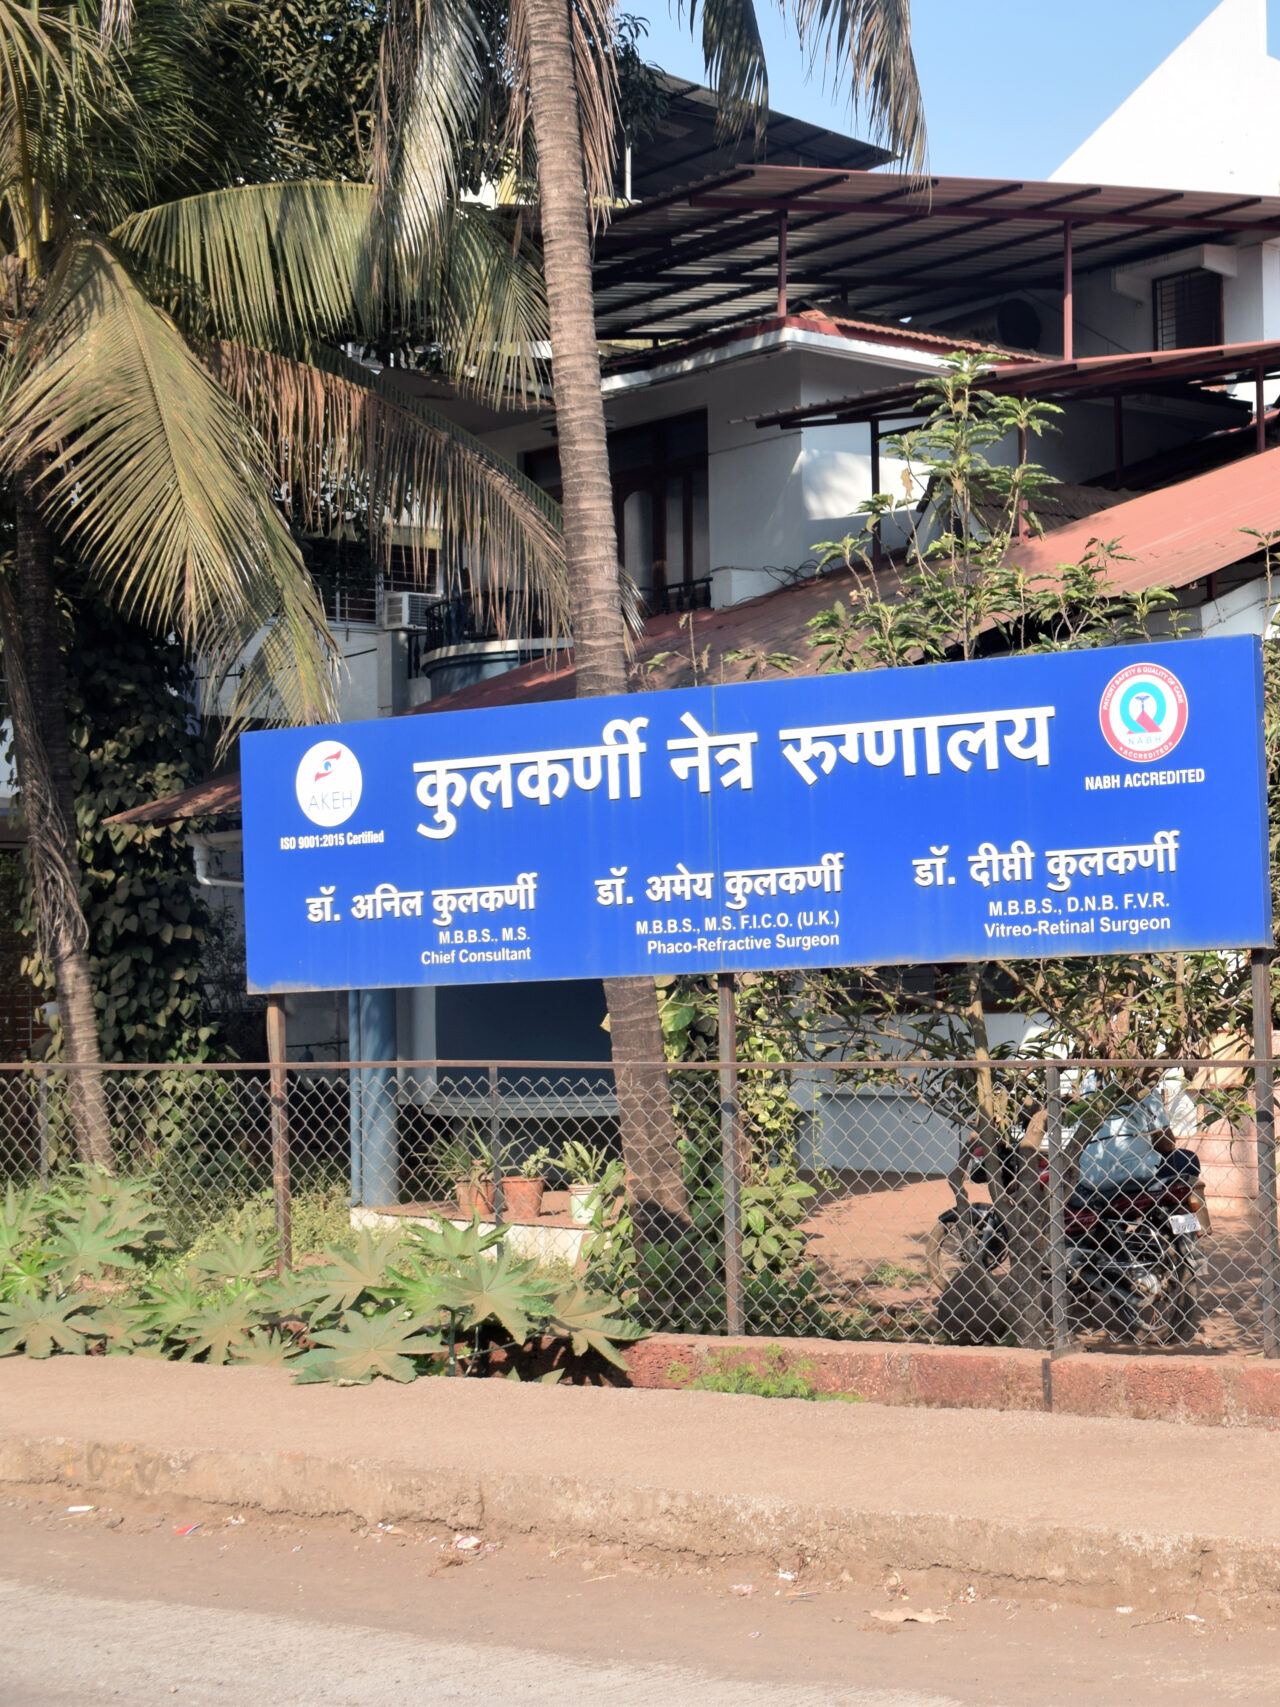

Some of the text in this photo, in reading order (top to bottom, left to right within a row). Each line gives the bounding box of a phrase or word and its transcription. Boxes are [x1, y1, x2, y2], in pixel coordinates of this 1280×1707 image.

[1114, 668, 1137, 688] SAFETY
[1142, 666, 1168, 680] QUALITY
[1122, 744, 1169, 760] ACCREDITED
[413, 705, 1056, 840] कुलकर्णी नेत्र रुग्णालय
[1085, 768, 1206, 791] NABH ACCREDITED
[306, 790, 353, 815] AKEH
[280, 830, 385, 850] ISO 9001:2015 Certified
[912, 829, 1181, 892] डॉ. दीप्ती कुलकर्णी
[595, 851, 845, 910] डॉ. अमेय कुलकर्णी
[306, 871, 539, 927] डॉ. अनिल कुलकर्णी
[989, 891, 1170, 917] M.B.B.S., D.N.B. F.V.R.
[502, 926, 530, 942] M.S.
[636, 909, 840, 936] M.B.B.S., M.S. F.I.C.O. (U.K.)
[984, 916, 1171, 940] Vitreo-Retinal Surgeon
[421, 945, 532, 966] Chief Consultant
[648, 931, 840, 956] Phaco-Refractive Surgeon
